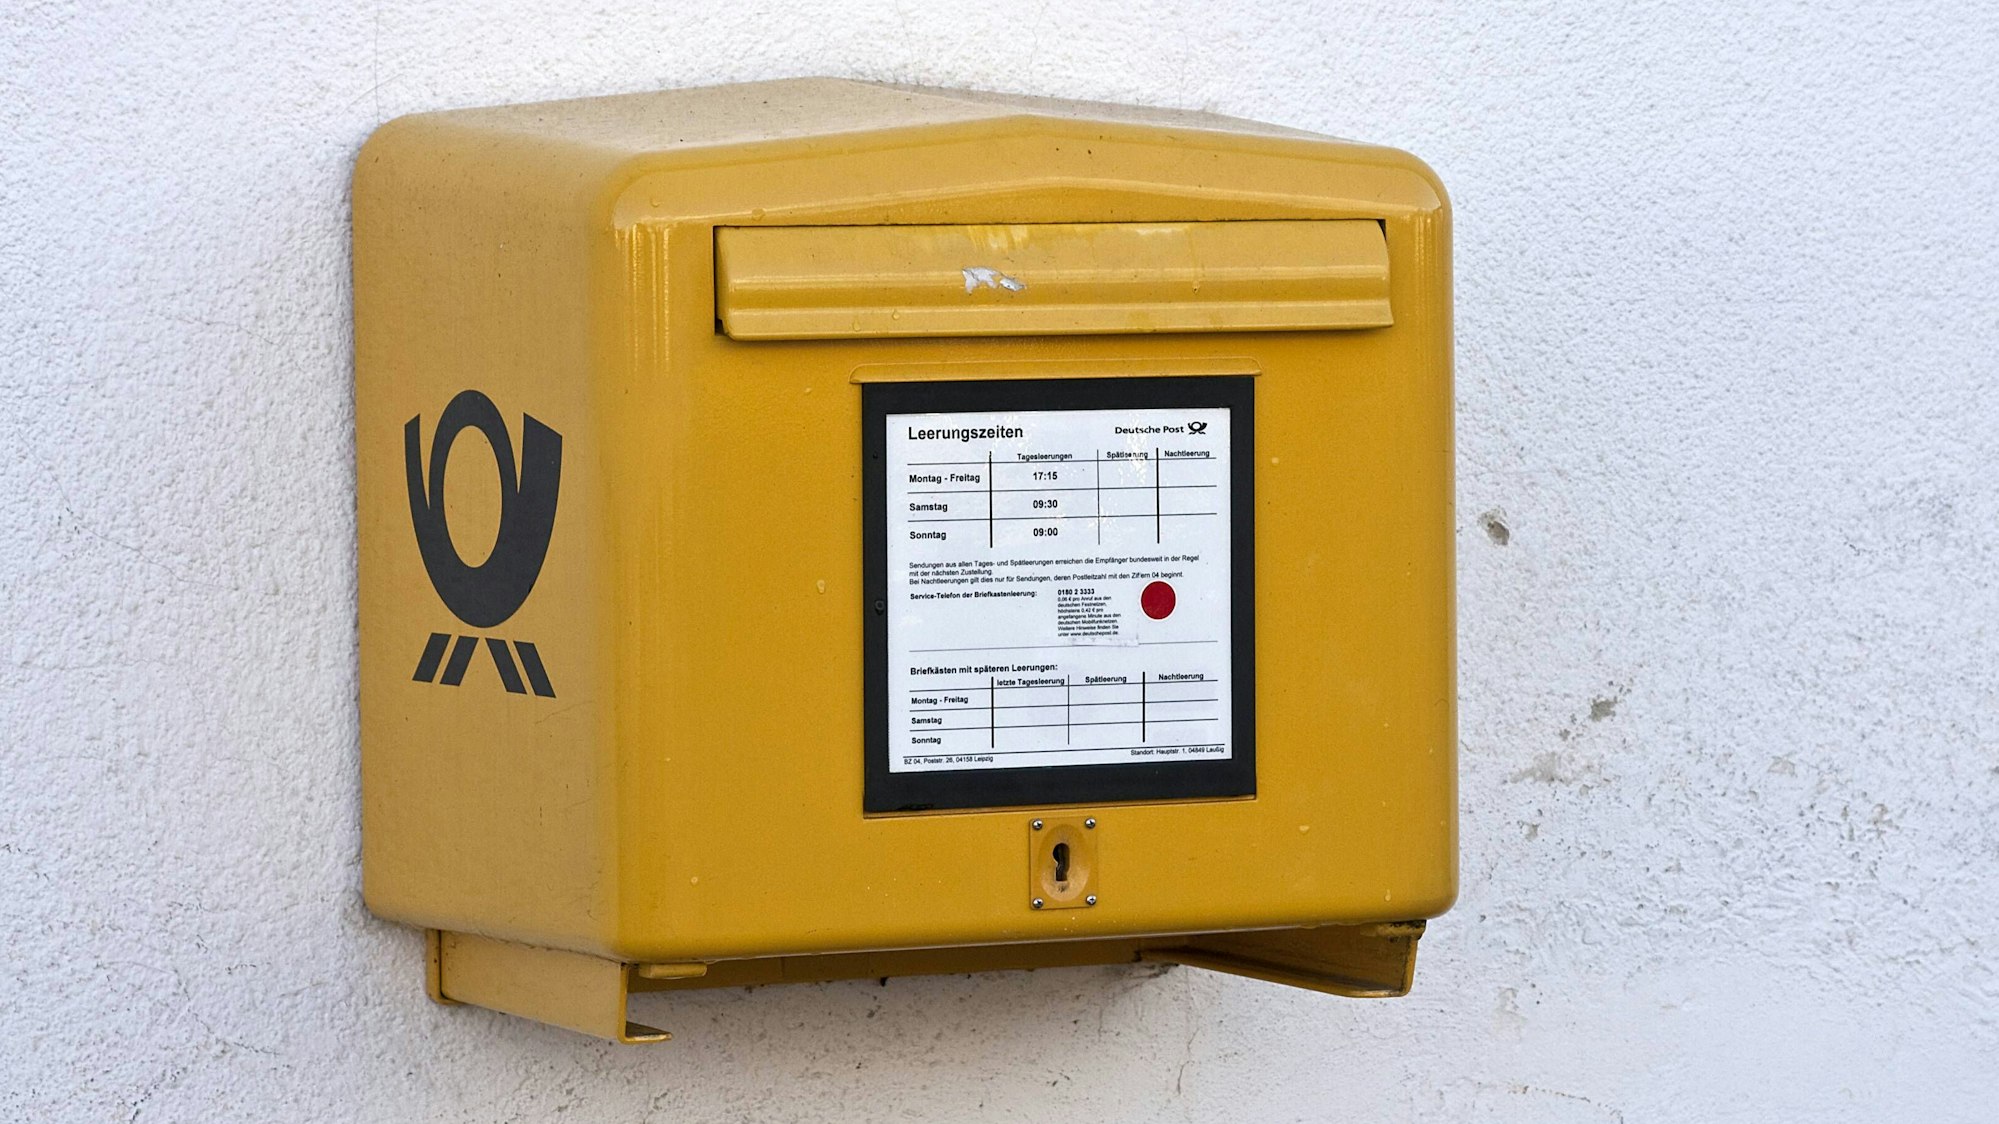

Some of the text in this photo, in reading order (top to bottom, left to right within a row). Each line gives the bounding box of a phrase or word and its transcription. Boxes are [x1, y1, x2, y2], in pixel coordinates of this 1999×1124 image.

[908, 425, 1023, 442] Leerungszeiten
[1115, 426, 1160, 434] Deutsche
[1017, 453, 1072, 461] Tagesleerungen
[1164, 450, 1210, 458] Nachtleerung
[909, 474, 942, 484] Montag
[950, 473, 980, 483] Freitag
[1033, 472, 1057, 481] 17:15
[909, 503, 948, 512] Samstag
[1033, 500, 1057, 509] 09:30
[910, 531, 946, 540] Sonntag
[1033, 528, 1058, 537] 09:00
[1010, 559, 1054, 567] Spätleerungen
[1095, 556, 1128, 565] Empfänger
[1182, 554, 1199, 562] Regel
[921, 577, 969, 585] Nachtleerungen
[970, 577, 980, 585] gilt
[910, 592, 961, 600] Service-Telefon
[974, 590, 1038, 598] Briefkastenleerung:
[910, 663, 1058, 676] Briefkästen mit späteren Leerungen:
[1085, 675, 1127, 684] Spätleerung
[1158, 672, 1204, 681] Nachtleerung
[997, 677, 1065, 687] letzte Tagesleerung
[944, 696, 969, 704] Freitag
[911, 716, 942, 724] Samstag
[911, 736, 941, 744] Sonntag
